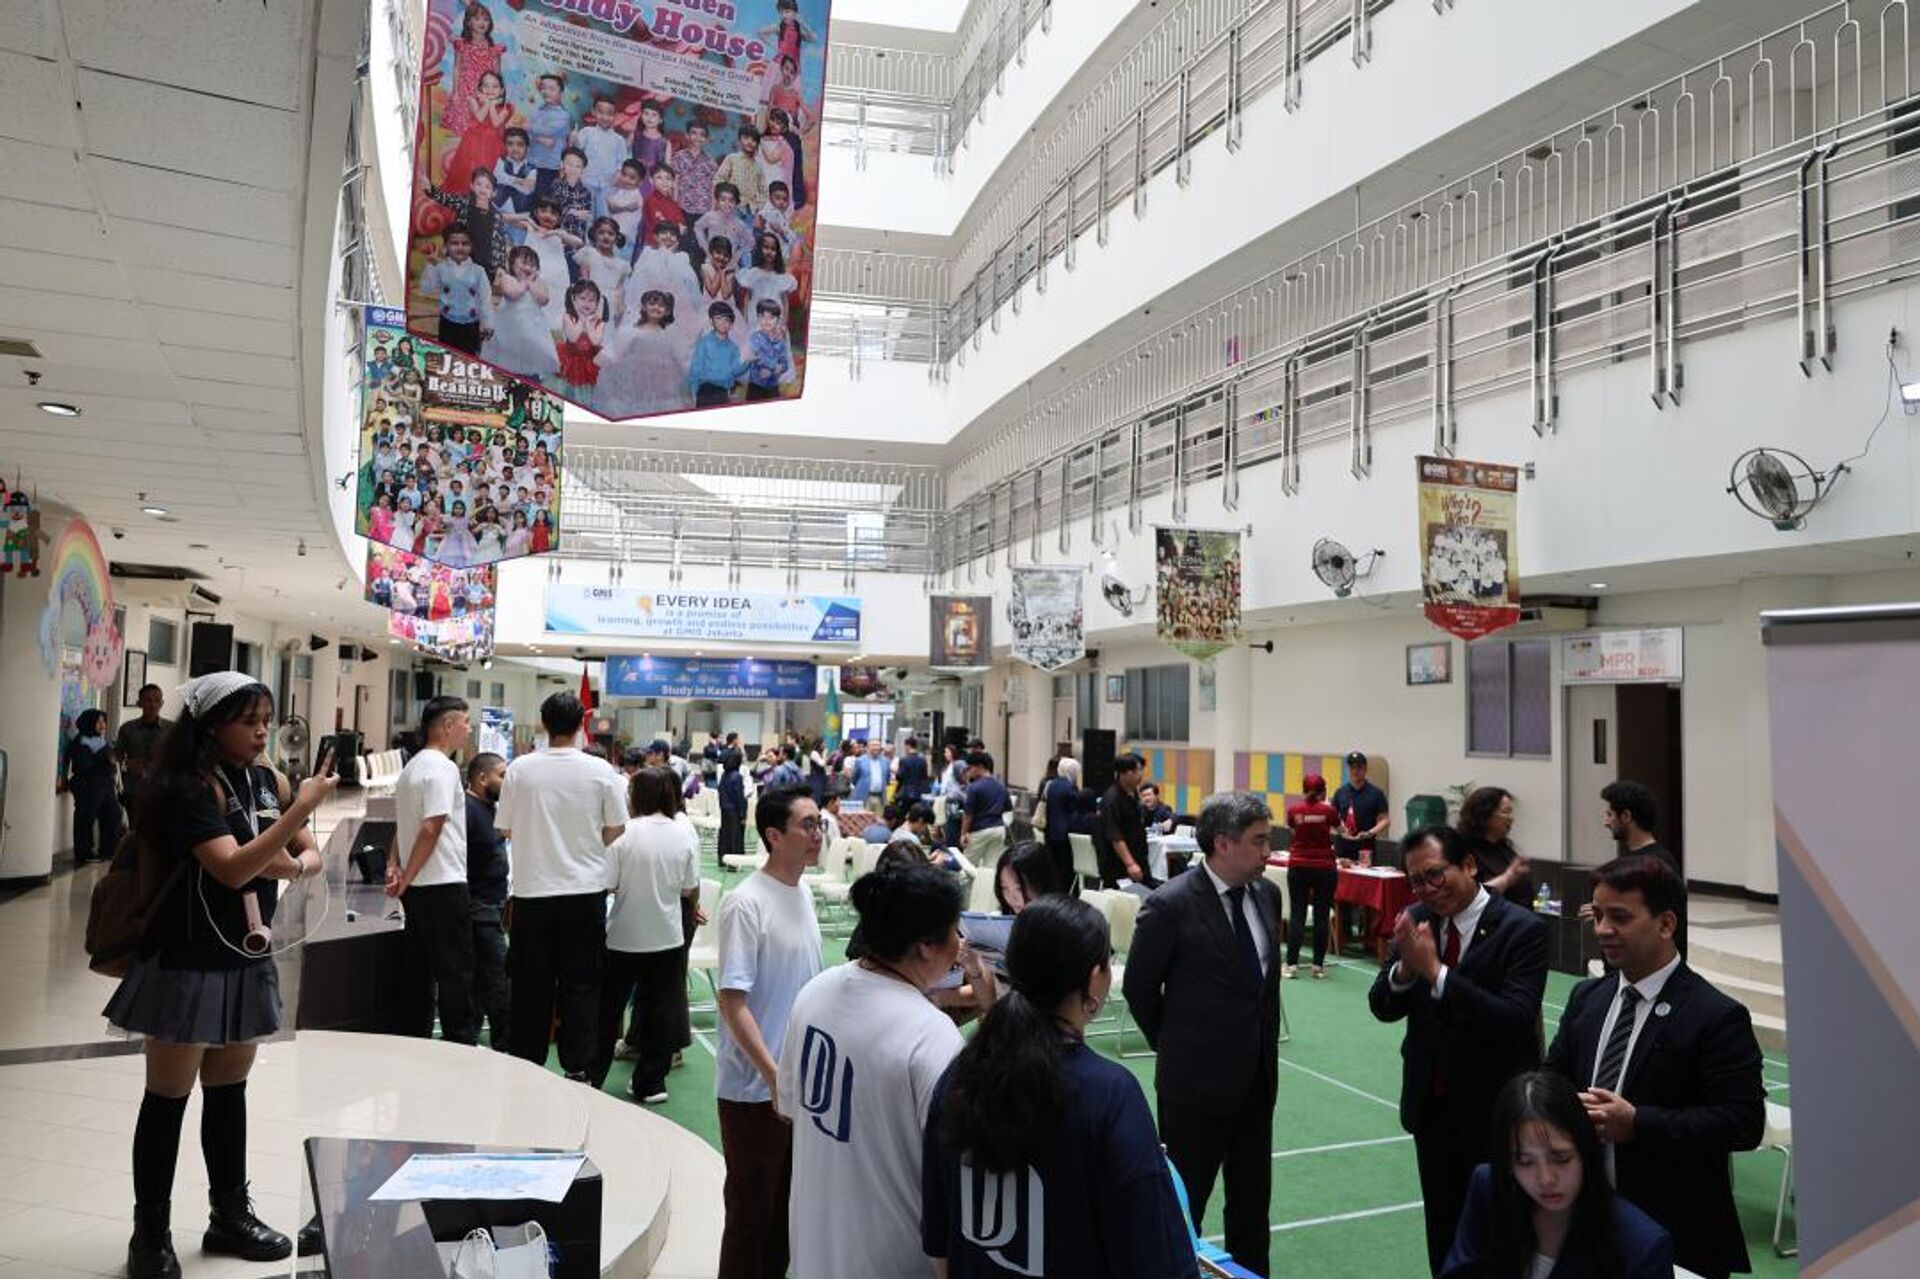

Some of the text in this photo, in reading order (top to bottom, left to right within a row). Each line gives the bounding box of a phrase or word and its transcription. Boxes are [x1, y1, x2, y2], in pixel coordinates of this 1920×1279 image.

[650, 7, 765, 61] House
[386, 311, 406, 322] GM
[436, 354, 495, 381] Jack
[428, 376, 509, 402] Beanstalk
[656, 594, 752, 610] EVERY IDEA
[686, 610, 730, 620] promise
[646, 616, 683, 627] growth
[687, 618, 706, 627] and
[708, 619, 747, 629] endless
[749, 620, 810, 633] possibilities
[705, 627, 743, 637] Jakarta
[661, 684, 768, 698] Study in Kazakhstan
